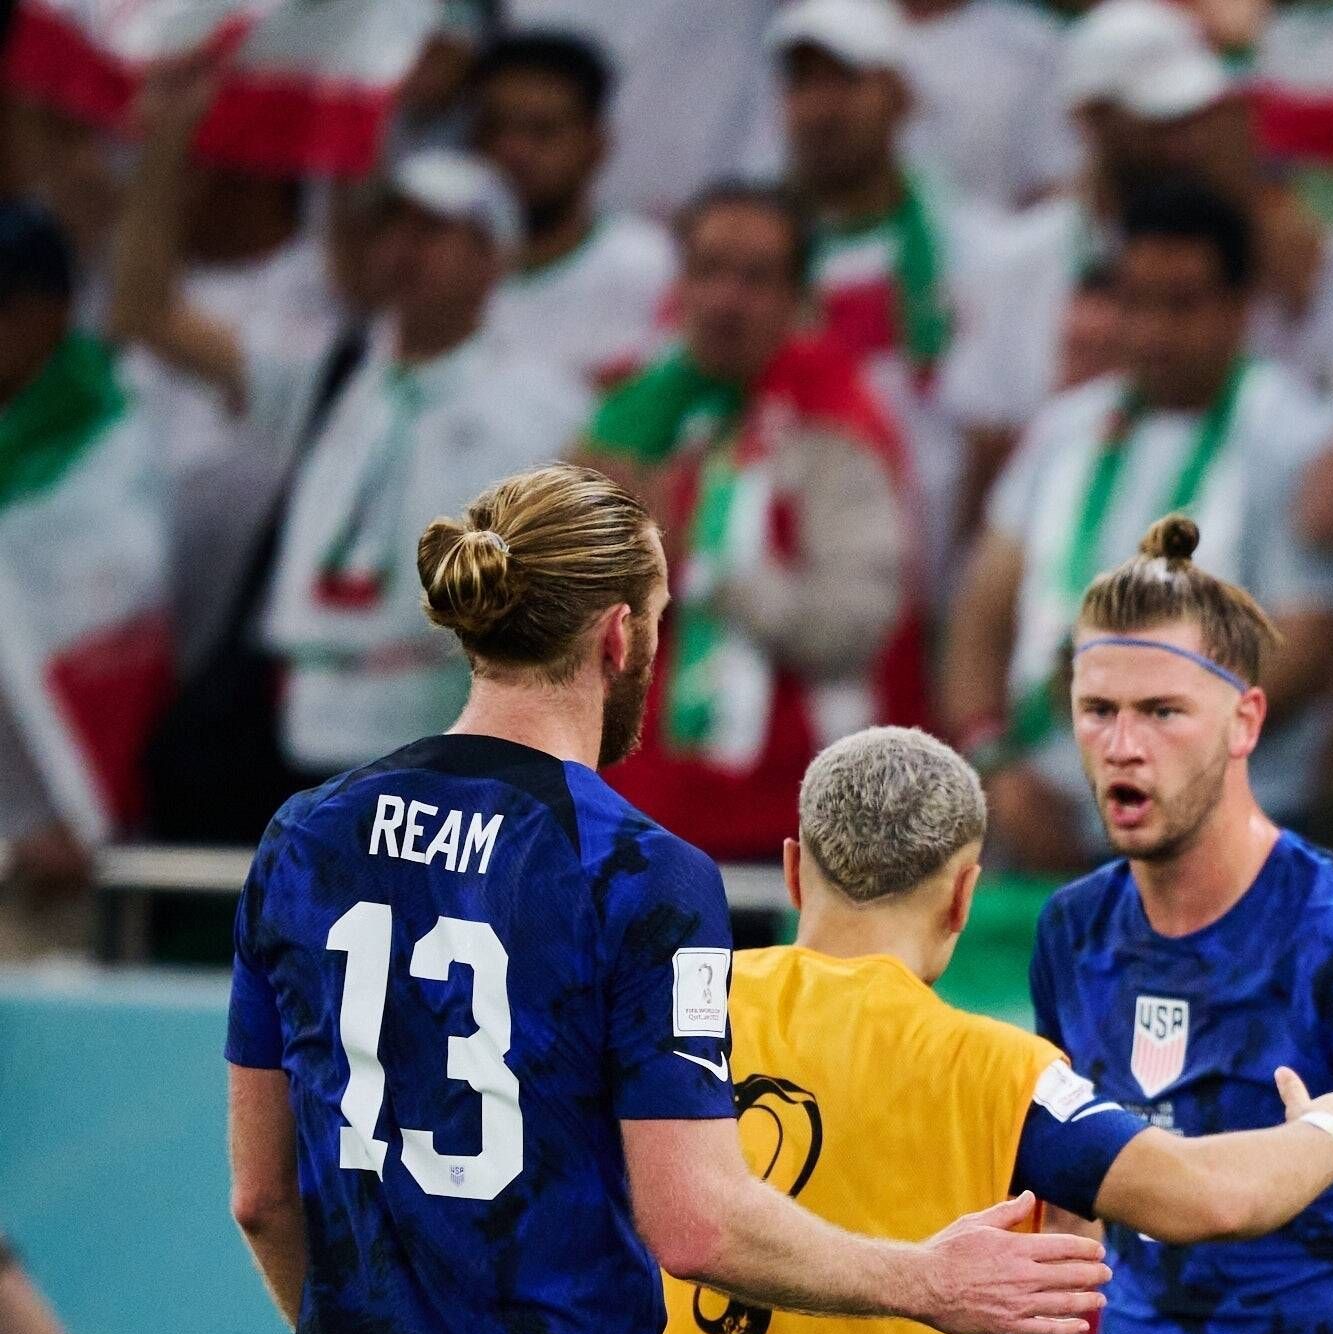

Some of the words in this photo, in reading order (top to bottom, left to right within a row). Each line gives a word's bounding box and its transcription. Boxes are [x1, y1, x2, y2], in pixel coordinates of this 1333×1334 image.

[369, 794, 505, 874] REAM
[326, 902, 523, 1200] 13
[1140, 1002, 1184, 1039] USA
